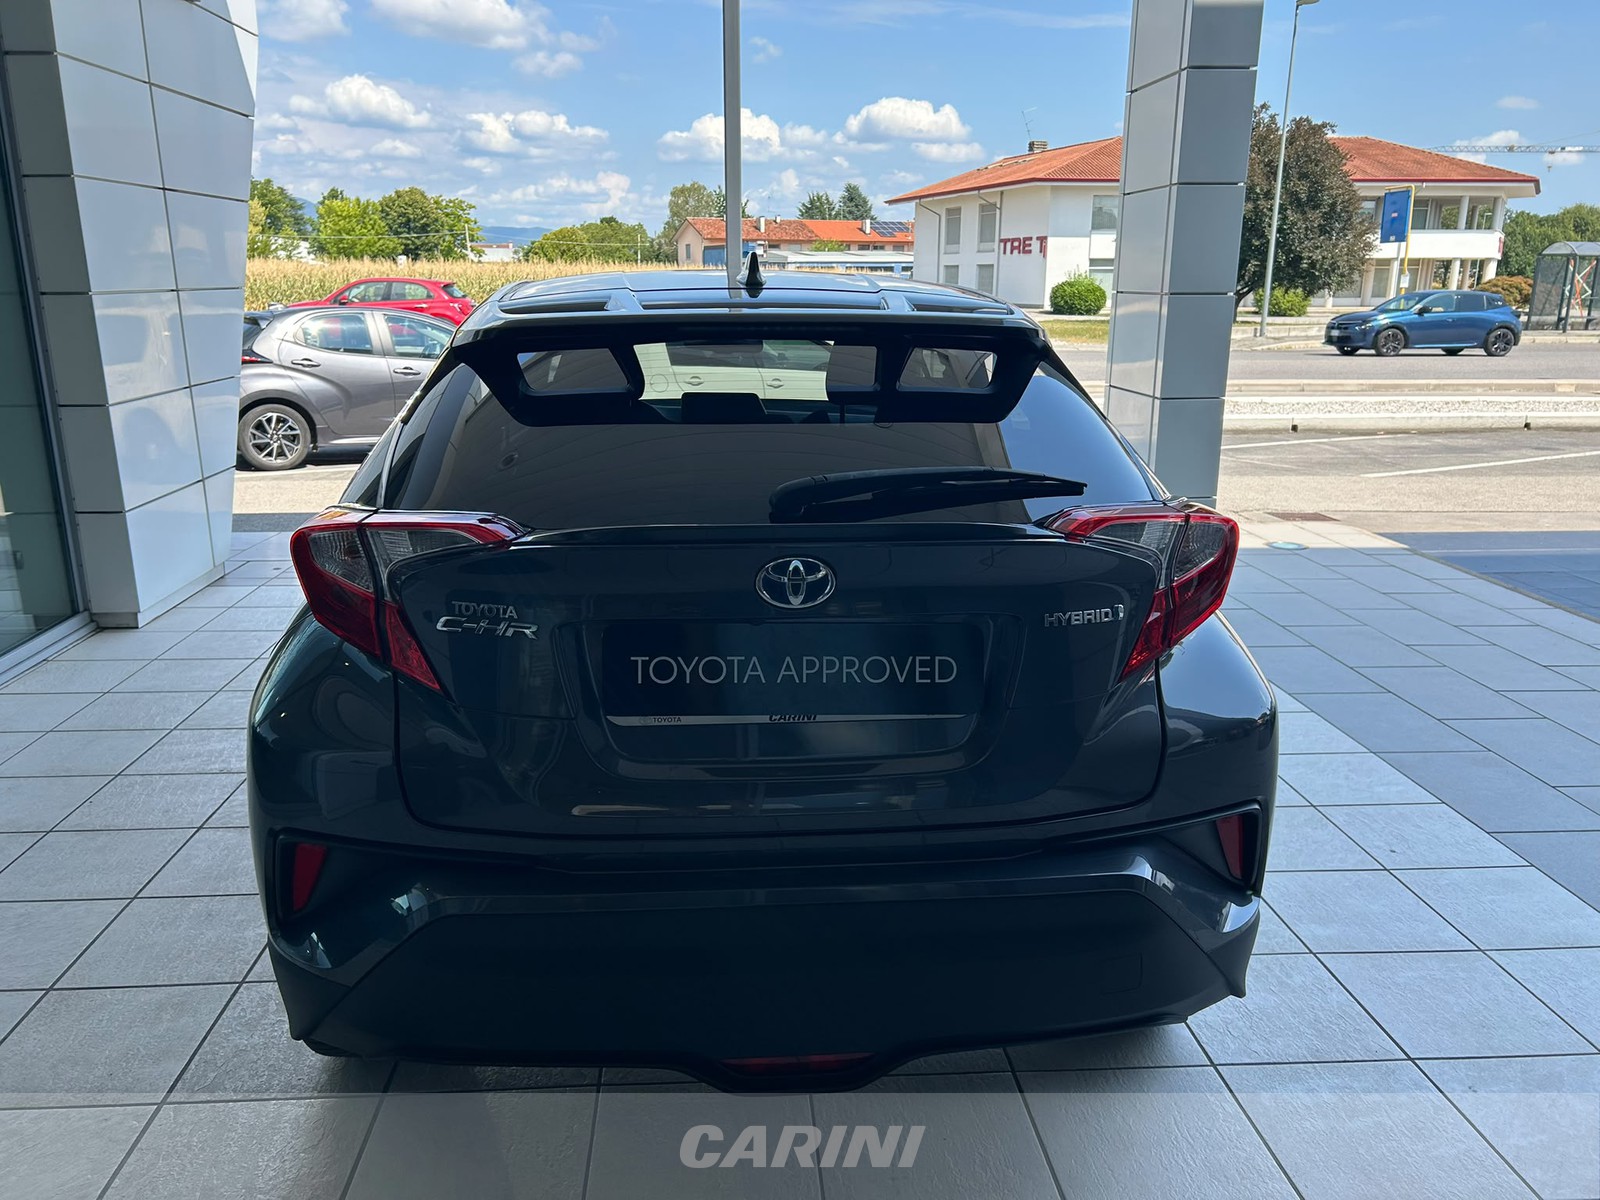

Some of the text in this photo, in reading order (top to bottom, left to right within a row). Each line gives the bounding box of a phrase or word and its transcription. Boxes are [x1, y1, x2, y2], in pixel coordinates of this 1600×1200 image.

[999, 237, 1033, 255] TRE
[451, 601, 518, 619] TOYOTA
[1044, 608, 1114, 627] HYBRID
[436, 616, 538, 639] C-HR
[630, 655, 958, 685] TOYOTA APPROVED
[652, 716, 682, 724] TOYOTA
[768, 714, 818, 723] CARINI
